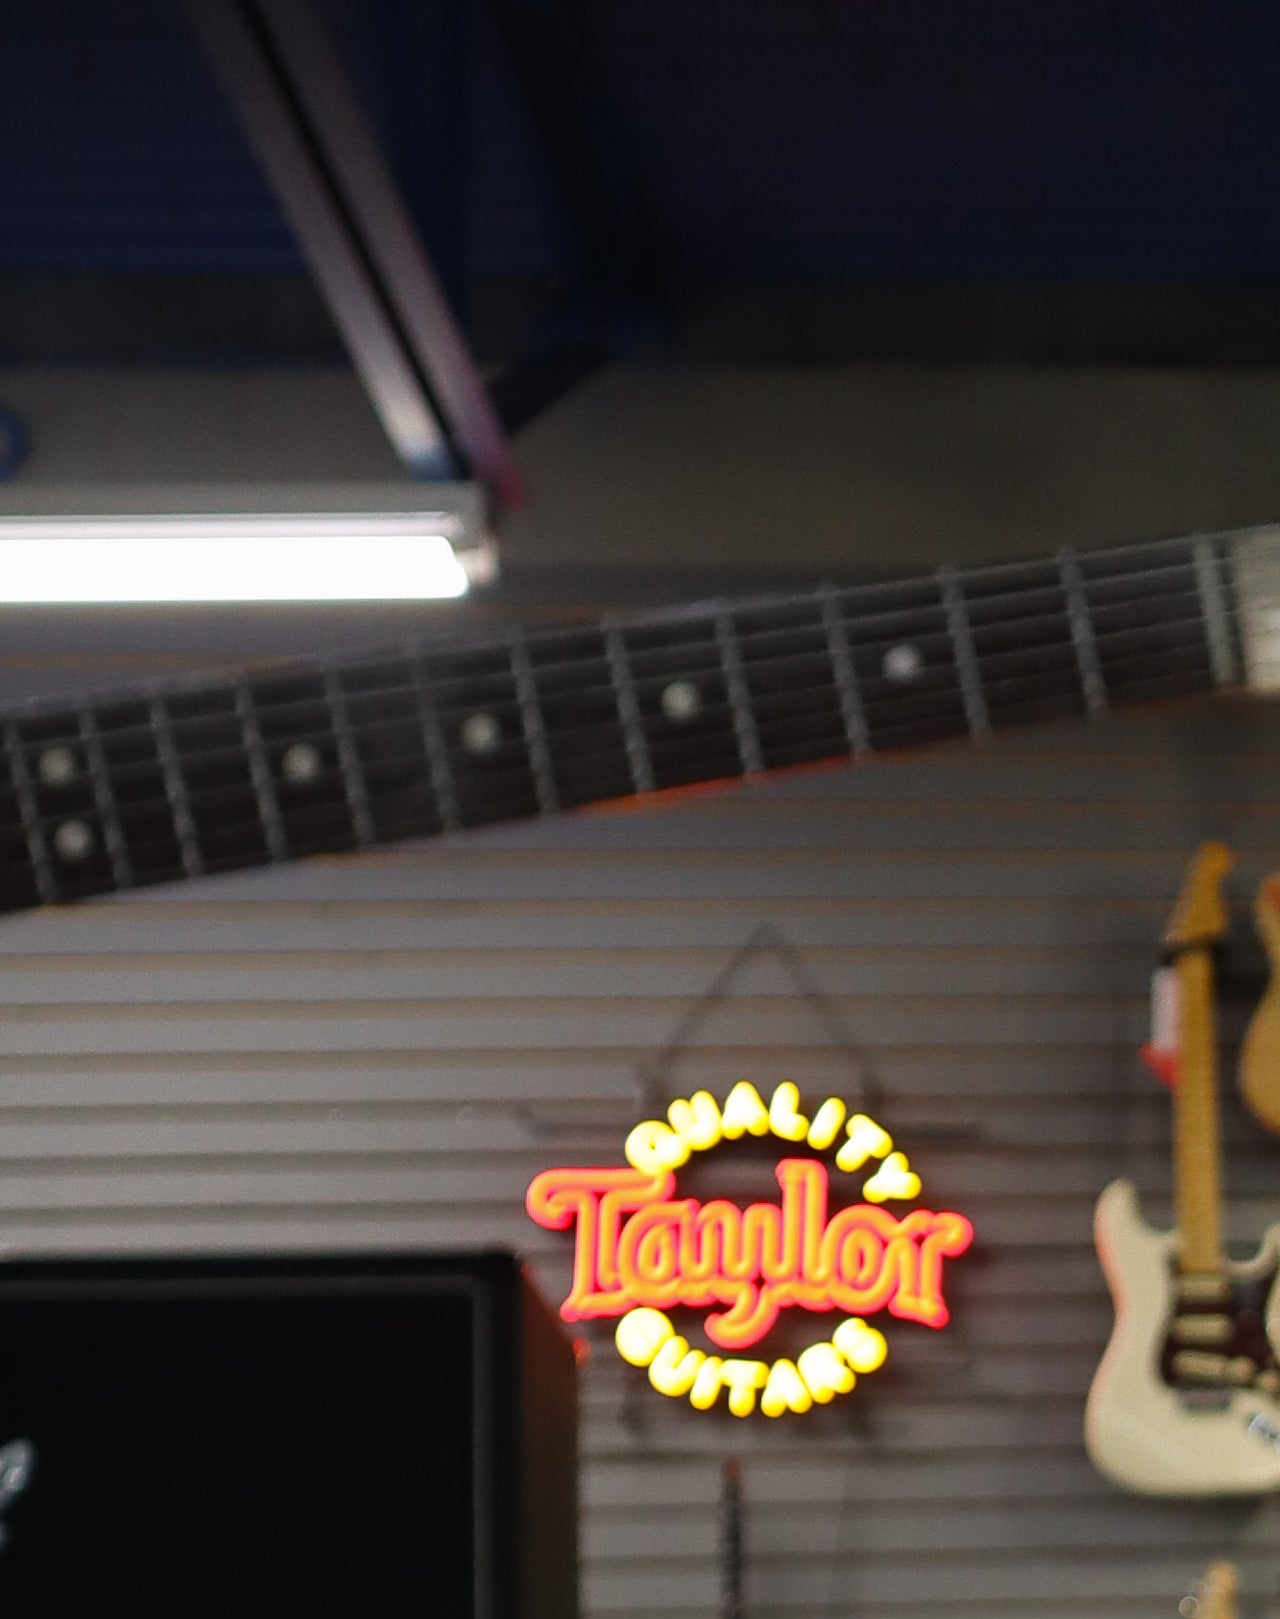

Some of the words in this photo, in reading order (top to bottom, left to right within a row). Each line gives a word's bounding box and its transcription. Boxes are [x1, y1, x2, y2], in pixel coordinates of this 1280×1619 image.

[624, 1080, 923, 1203] QUALITY
[526, 1158, 975, 1350] Taylor
[614, 1306, 889, 1418] GUITARS
